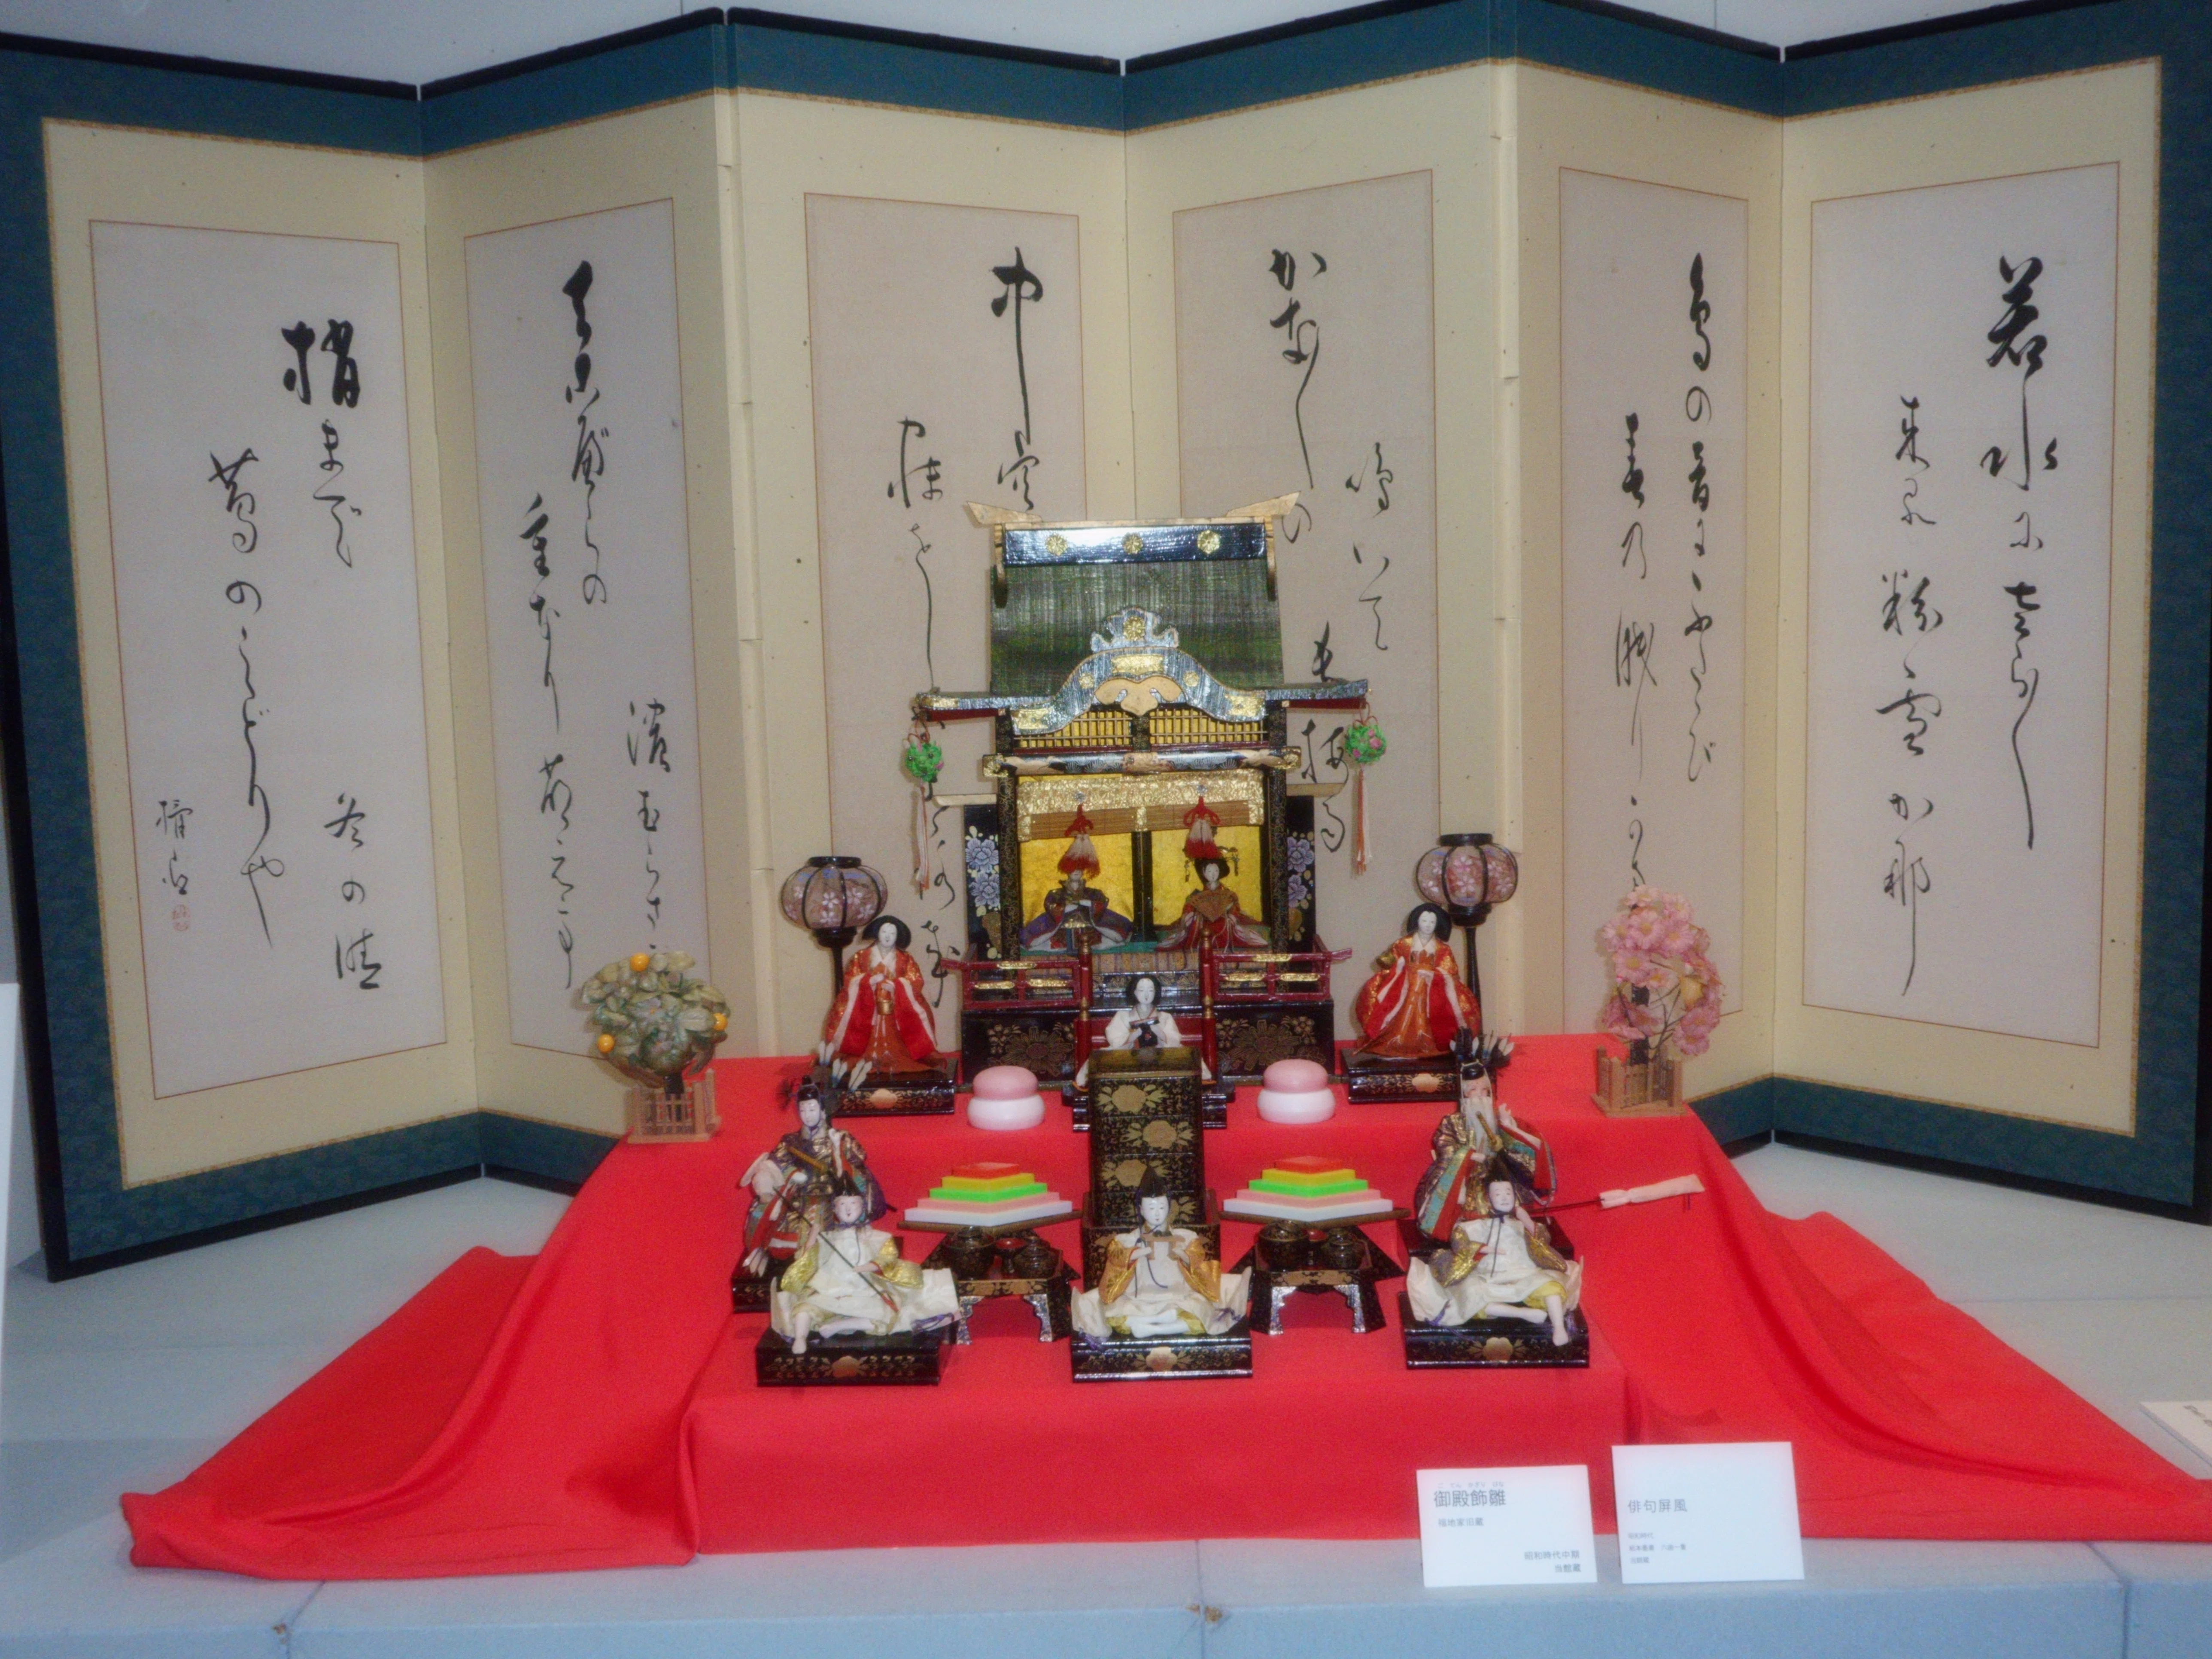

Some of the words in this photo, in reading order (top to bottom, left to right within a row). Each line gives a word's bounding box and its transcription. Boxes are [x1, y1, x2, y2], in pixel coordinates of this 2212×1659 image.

[1434, 1489, 1506, 1508] 御殿飾雛
[1628, 1499, 1687, 1513] 俳句屏風
[1524, 1549, 1580, 1561] 昭和時代中期
[1555, 1563, 1581, 1573] 当館蔵
